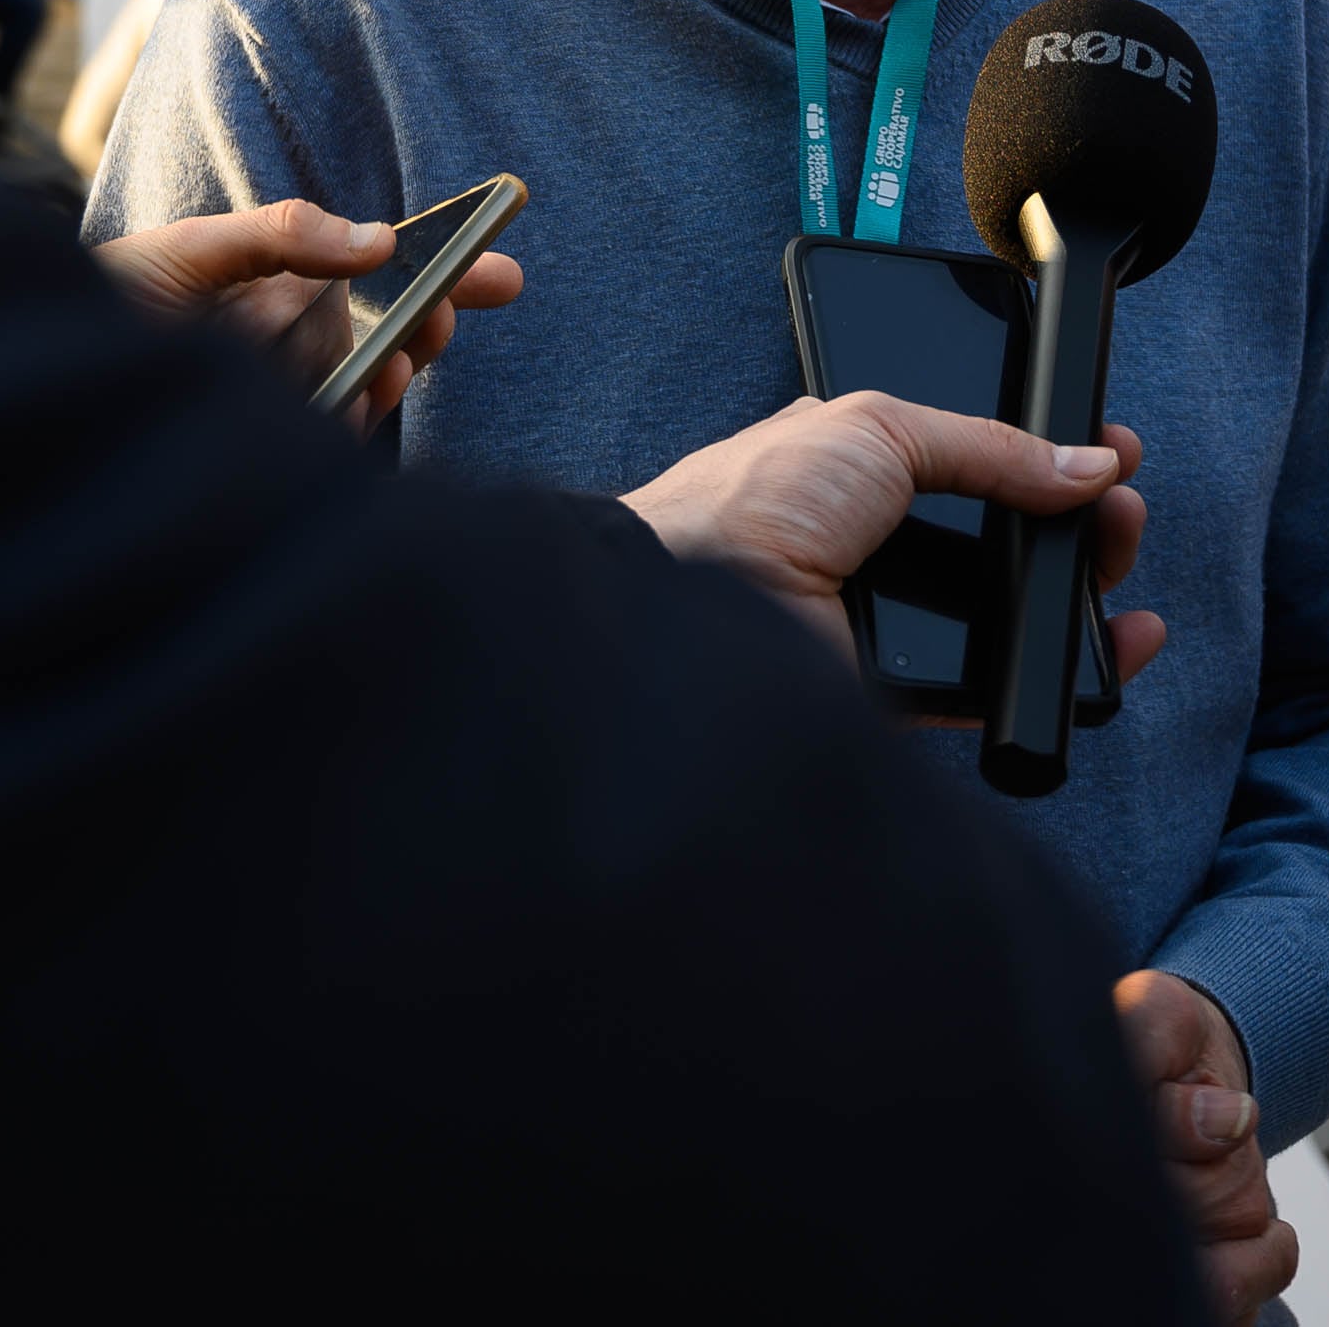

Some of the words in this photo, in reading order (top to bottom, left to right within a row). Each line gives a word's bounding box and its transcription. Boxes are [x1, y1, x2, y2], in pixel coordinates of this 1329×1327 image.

[1024, 30, 1194, 104] RØDE
[875, 126, 888, 165] GRUPO
[884, 88, 905, 167] COOPERATIVO
[893, 115, 910, 169] CAJAMAR
[807, 144, 817, 201] CAJAMAR
